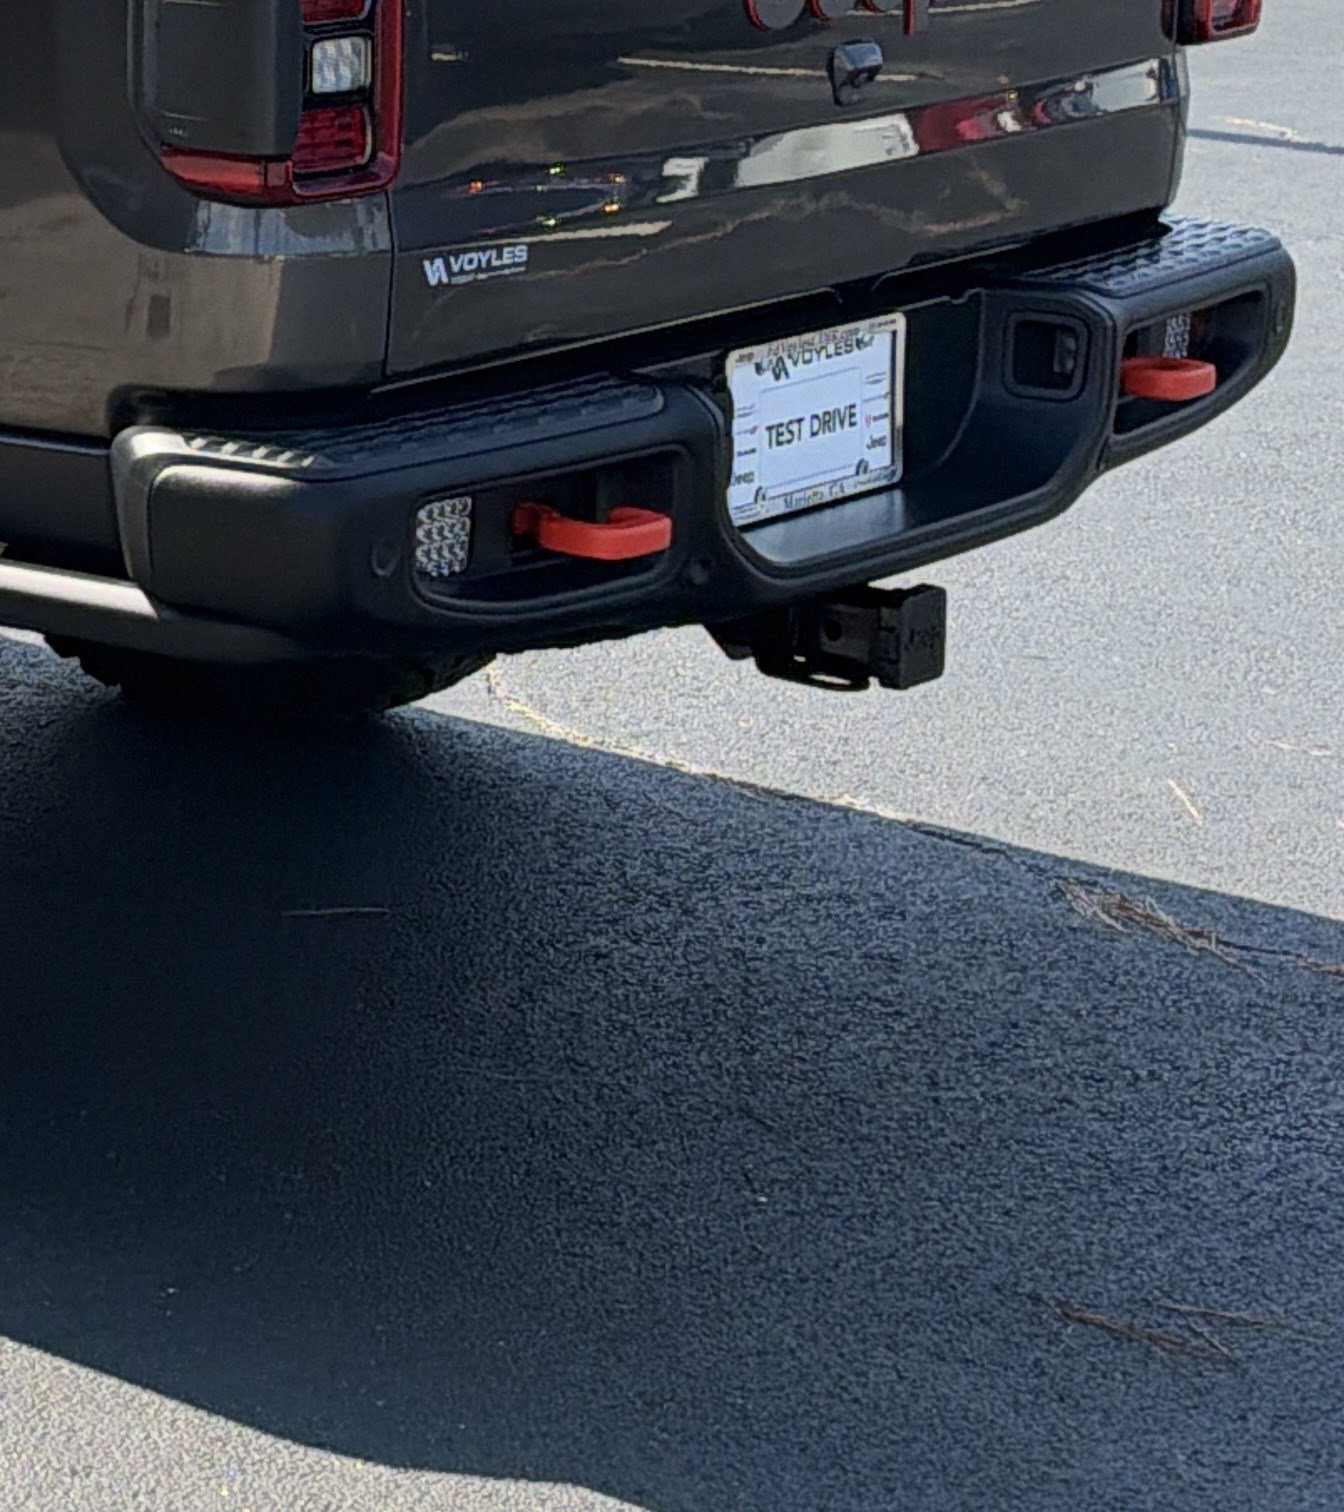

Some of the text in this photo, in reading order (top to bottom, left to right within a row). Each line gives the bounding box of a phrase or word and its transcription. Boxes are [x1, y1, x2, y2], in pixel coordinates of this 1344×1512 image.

[449, 245, 529, 273] VOYLES
[788, 340, 855, 368] VOYLES
[765, 403, 858, 449] TEST DRIVE
